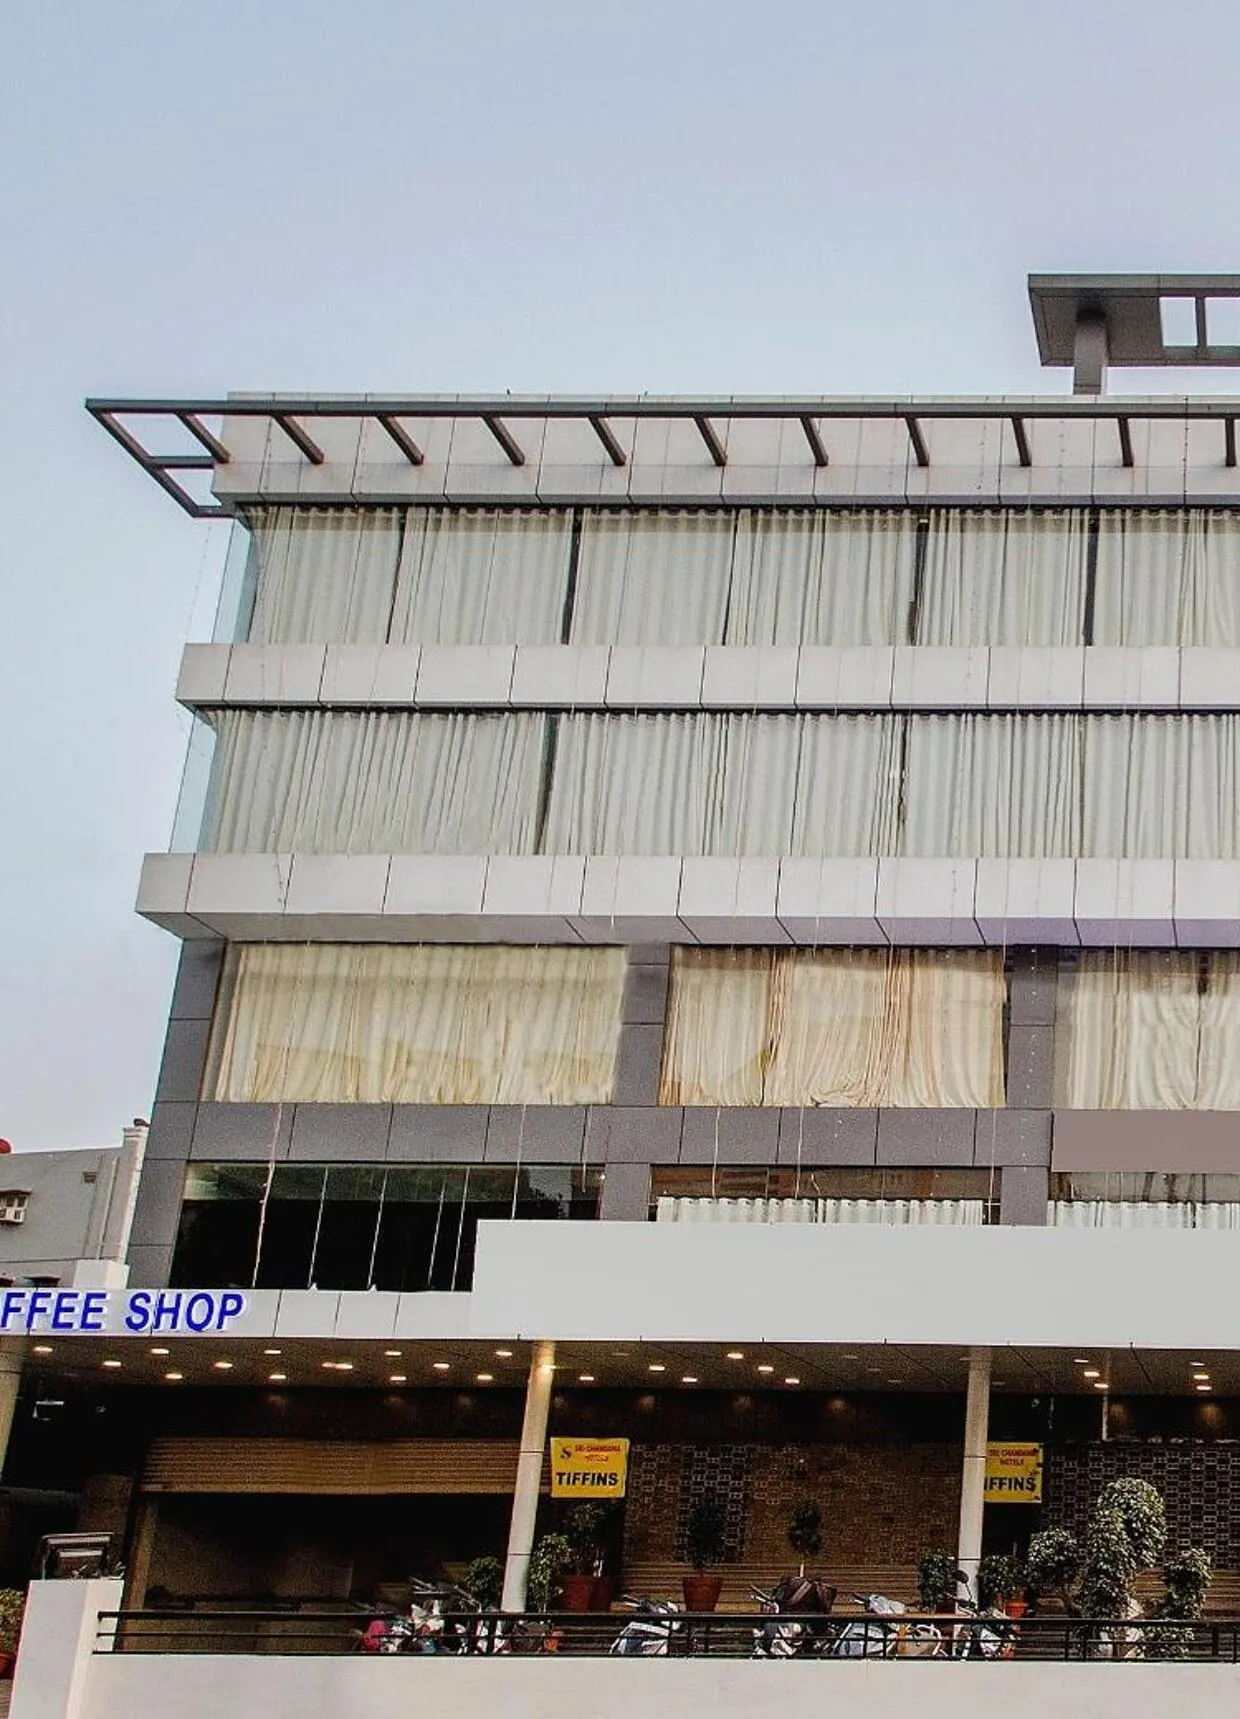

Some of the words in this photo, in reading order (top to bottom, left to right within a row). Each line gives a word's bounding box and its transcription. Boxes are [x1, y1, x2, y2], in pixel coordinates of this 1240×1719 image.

[0, 1292, 108, 1330] FFEE
[125, 1292, 243, 1331] SHOP
[556, 1472, 618, 1486] TIFFINS
[983, 1477, 1037, 1492] IFFINS
